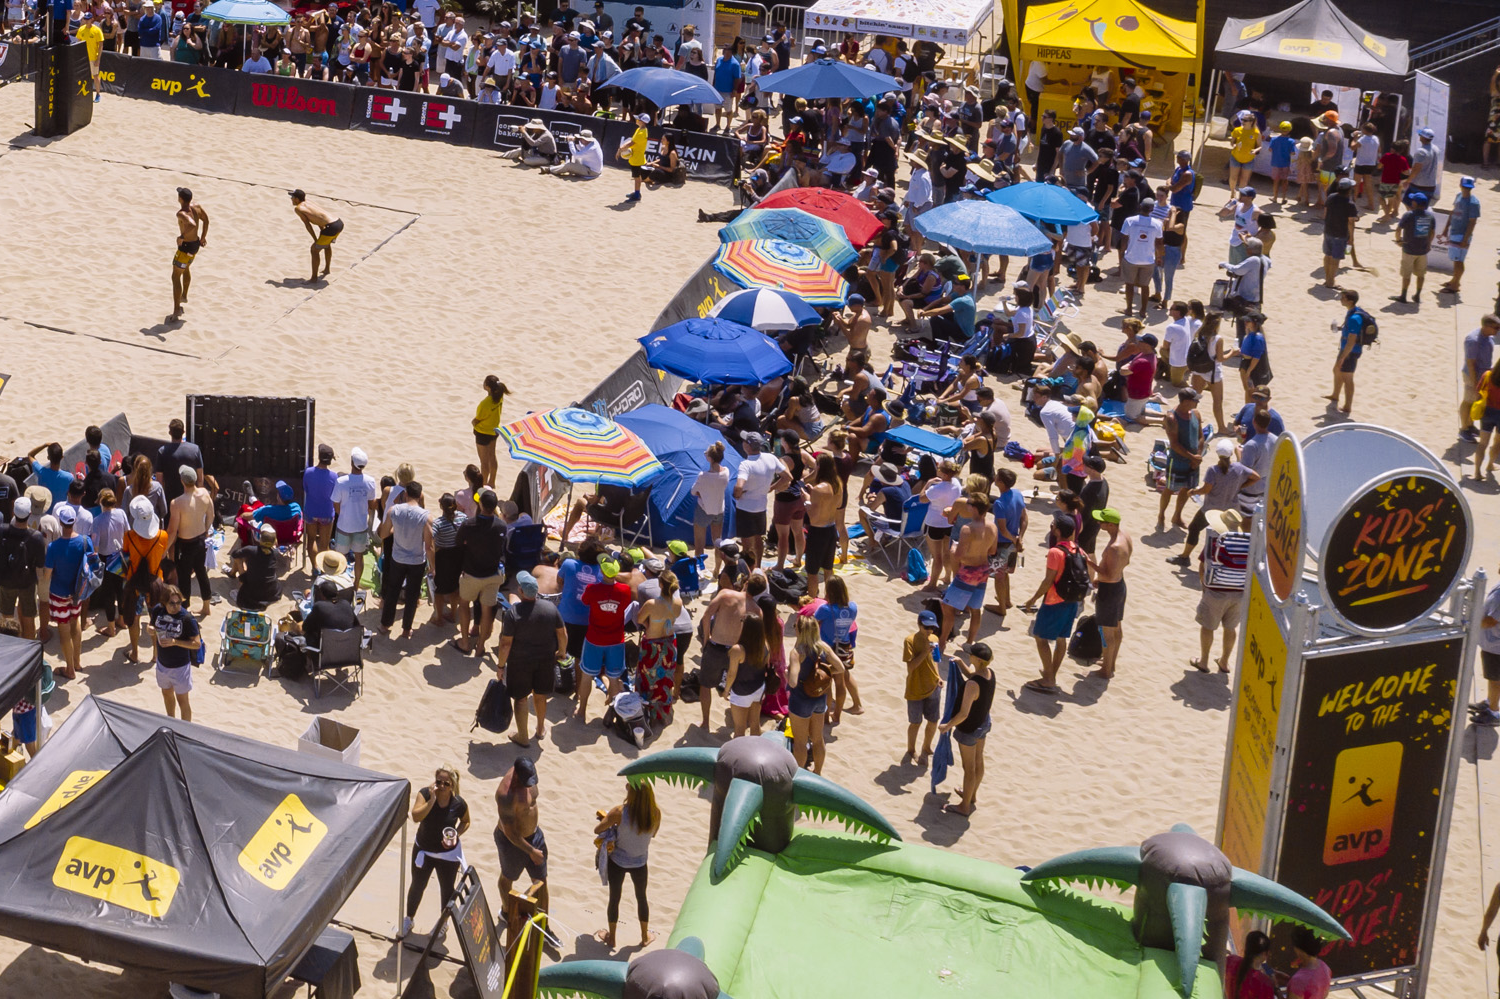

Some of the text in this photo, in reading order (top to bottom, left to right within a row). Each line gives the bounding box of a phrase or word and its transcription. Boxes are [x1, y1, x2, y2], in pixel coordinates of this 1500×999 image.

[716, 5, 759, 17] PRODUCTION
[1037, 48, 1071, 60] HIPPEAS
[1284, 42, 1310, 53] avp
[151, 76, 182, 95] avp
[251, 82, 337, 116] Wilson
[609, 387, 642, 419] HYDRO
[1354, 498, 1444, 555] KIDS'
[1338, 525, 1456, 596] ZONE!
[1318, 664, 1437, 717] WELCOME
[1345, 701, 1403, 735] TO THE
[1333, 829, 1383, 853] avp
[65, 856, 116, 889] avp
[259, 841, 293, 880] avp
